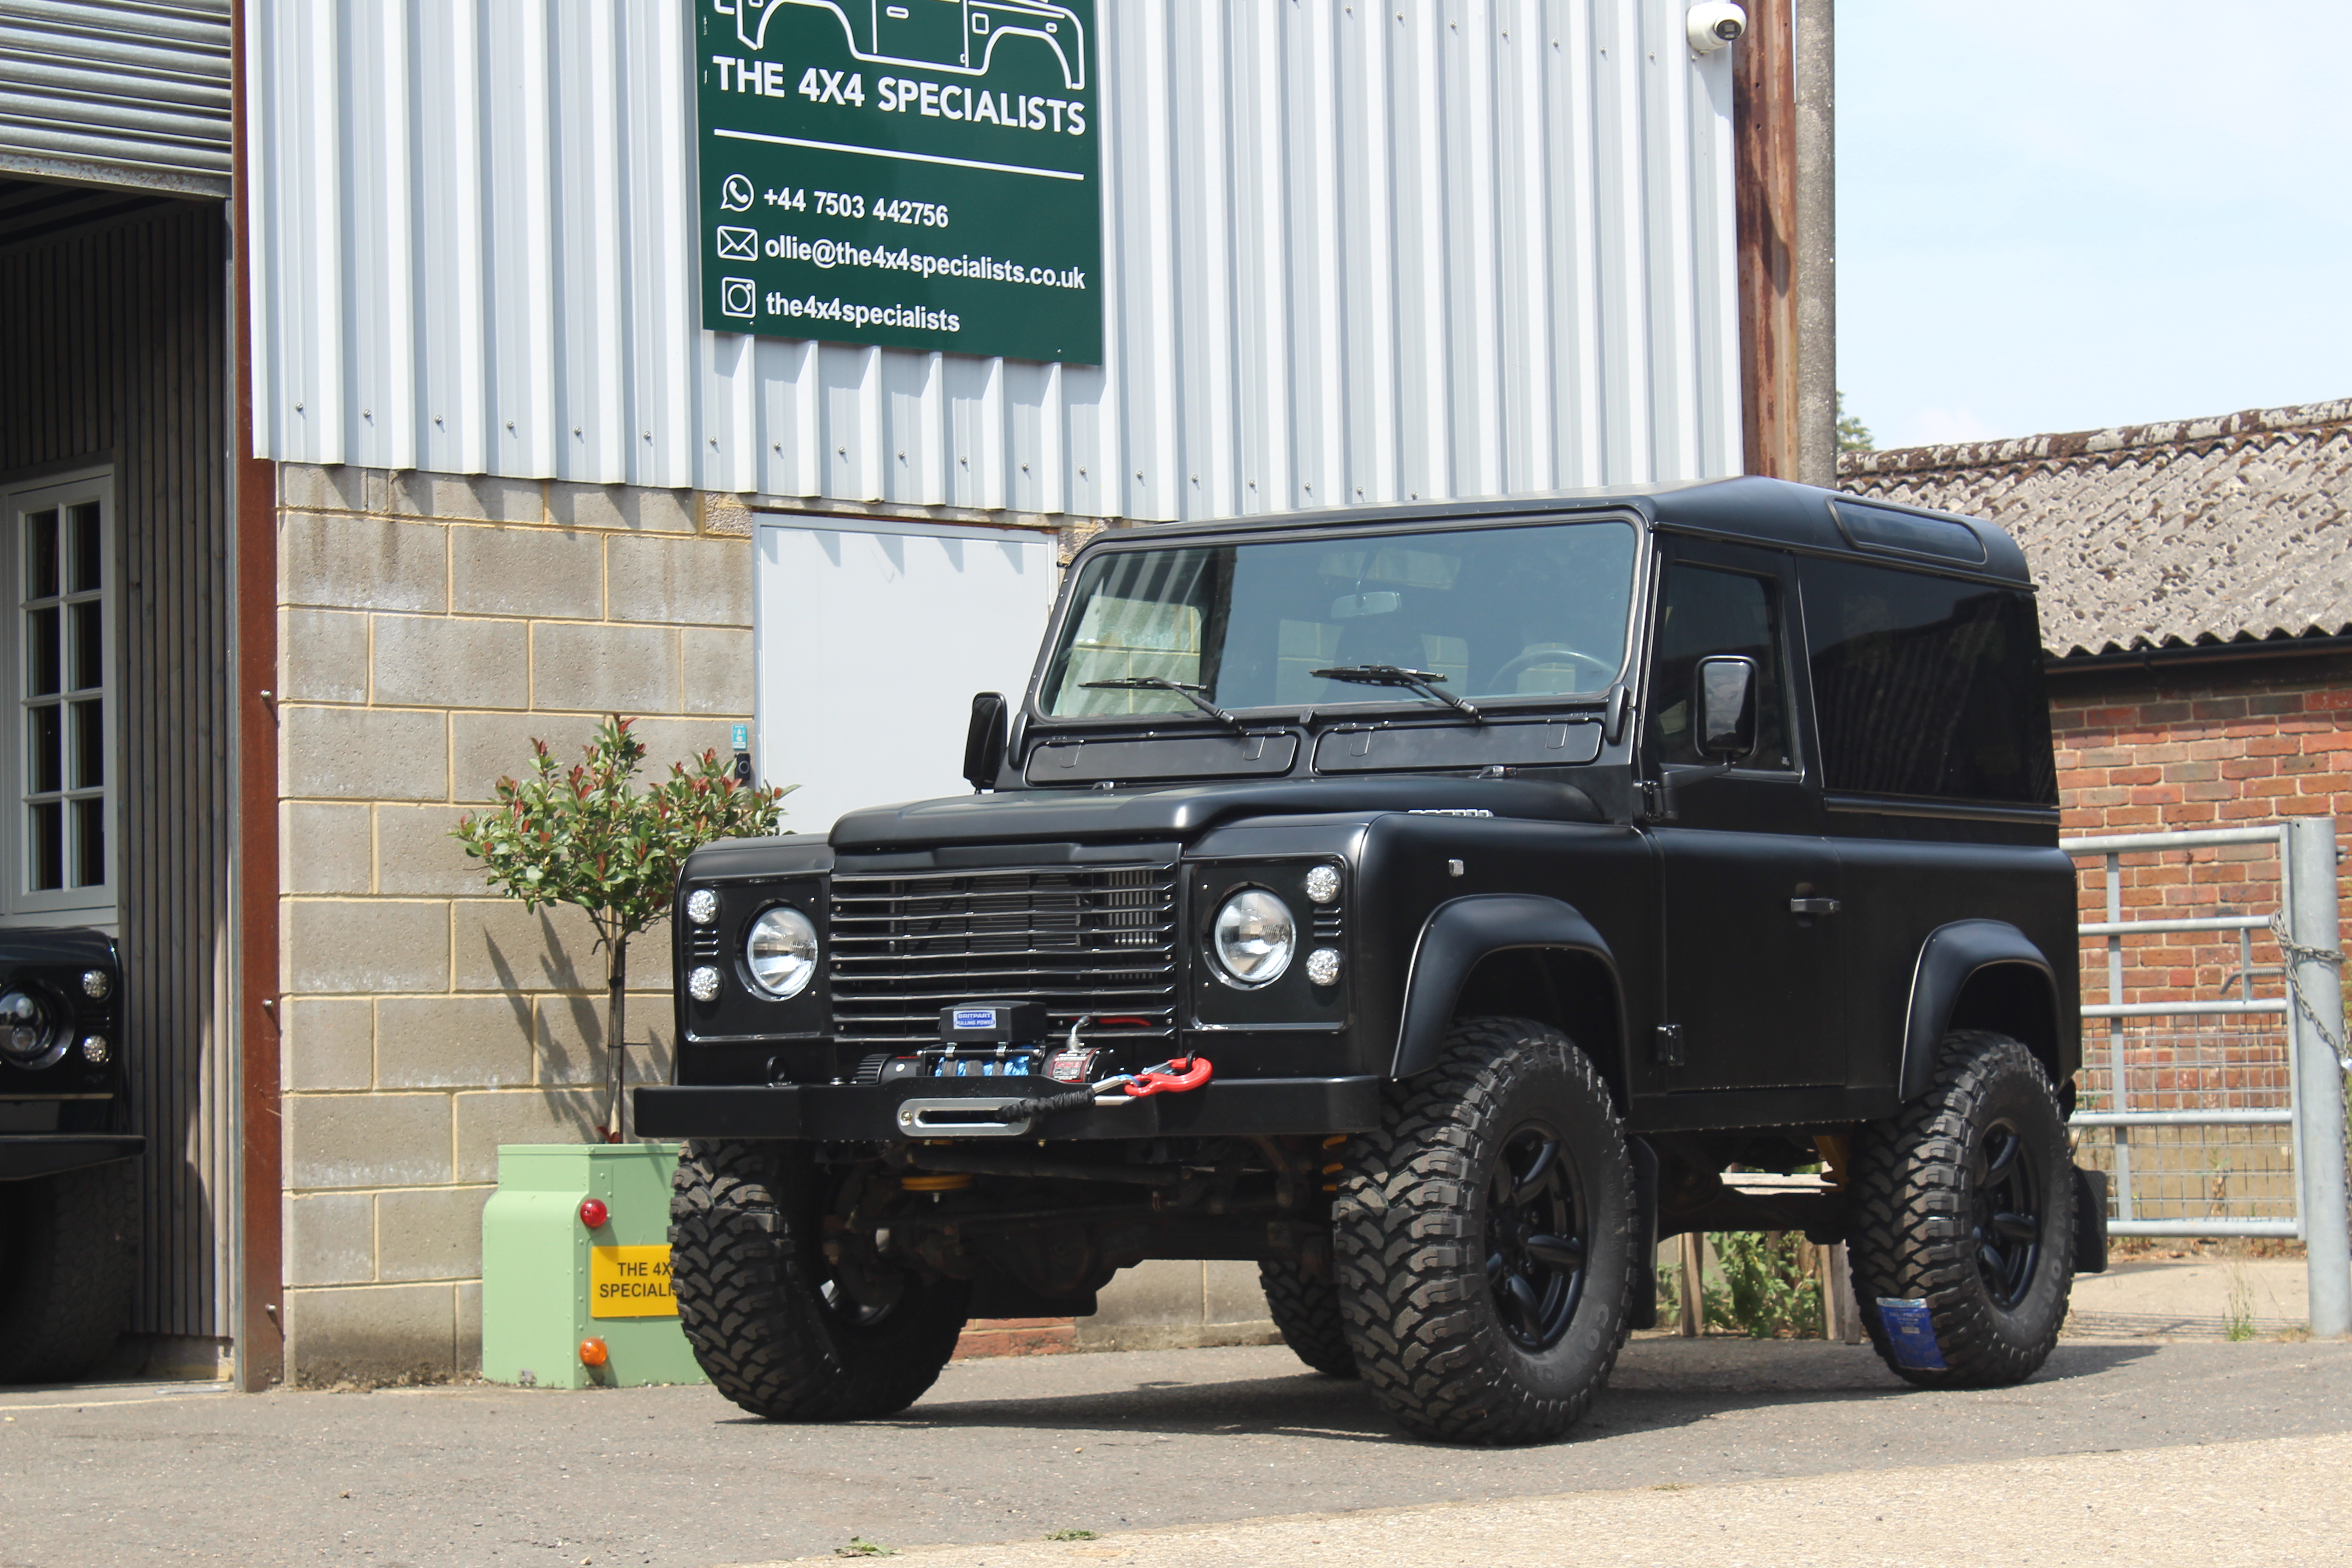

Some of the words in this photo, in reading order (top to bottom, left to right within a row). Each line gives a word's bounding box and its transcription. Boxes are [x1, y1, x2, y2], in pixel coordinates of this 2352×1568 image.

[713, 55, 785, 98] THE
[799, 68, 865, 107] 4X4
[877, 76, 1086, 136] SPECIALISTS
[764, 188, 806, 212] +44
[814, 191, 865, 219] 7503
[872, 198, 949, 228] 442756
[765, 235, 1086, 289] ollie@the4x4specialists.co.uk
[766, 292, 960, 332] the4x4specialists
[617, 1262, 648, 1276] THE
[653, 1262, 672, 1275] 4X
[600, 1283, 676, 1298] SPECIALI
